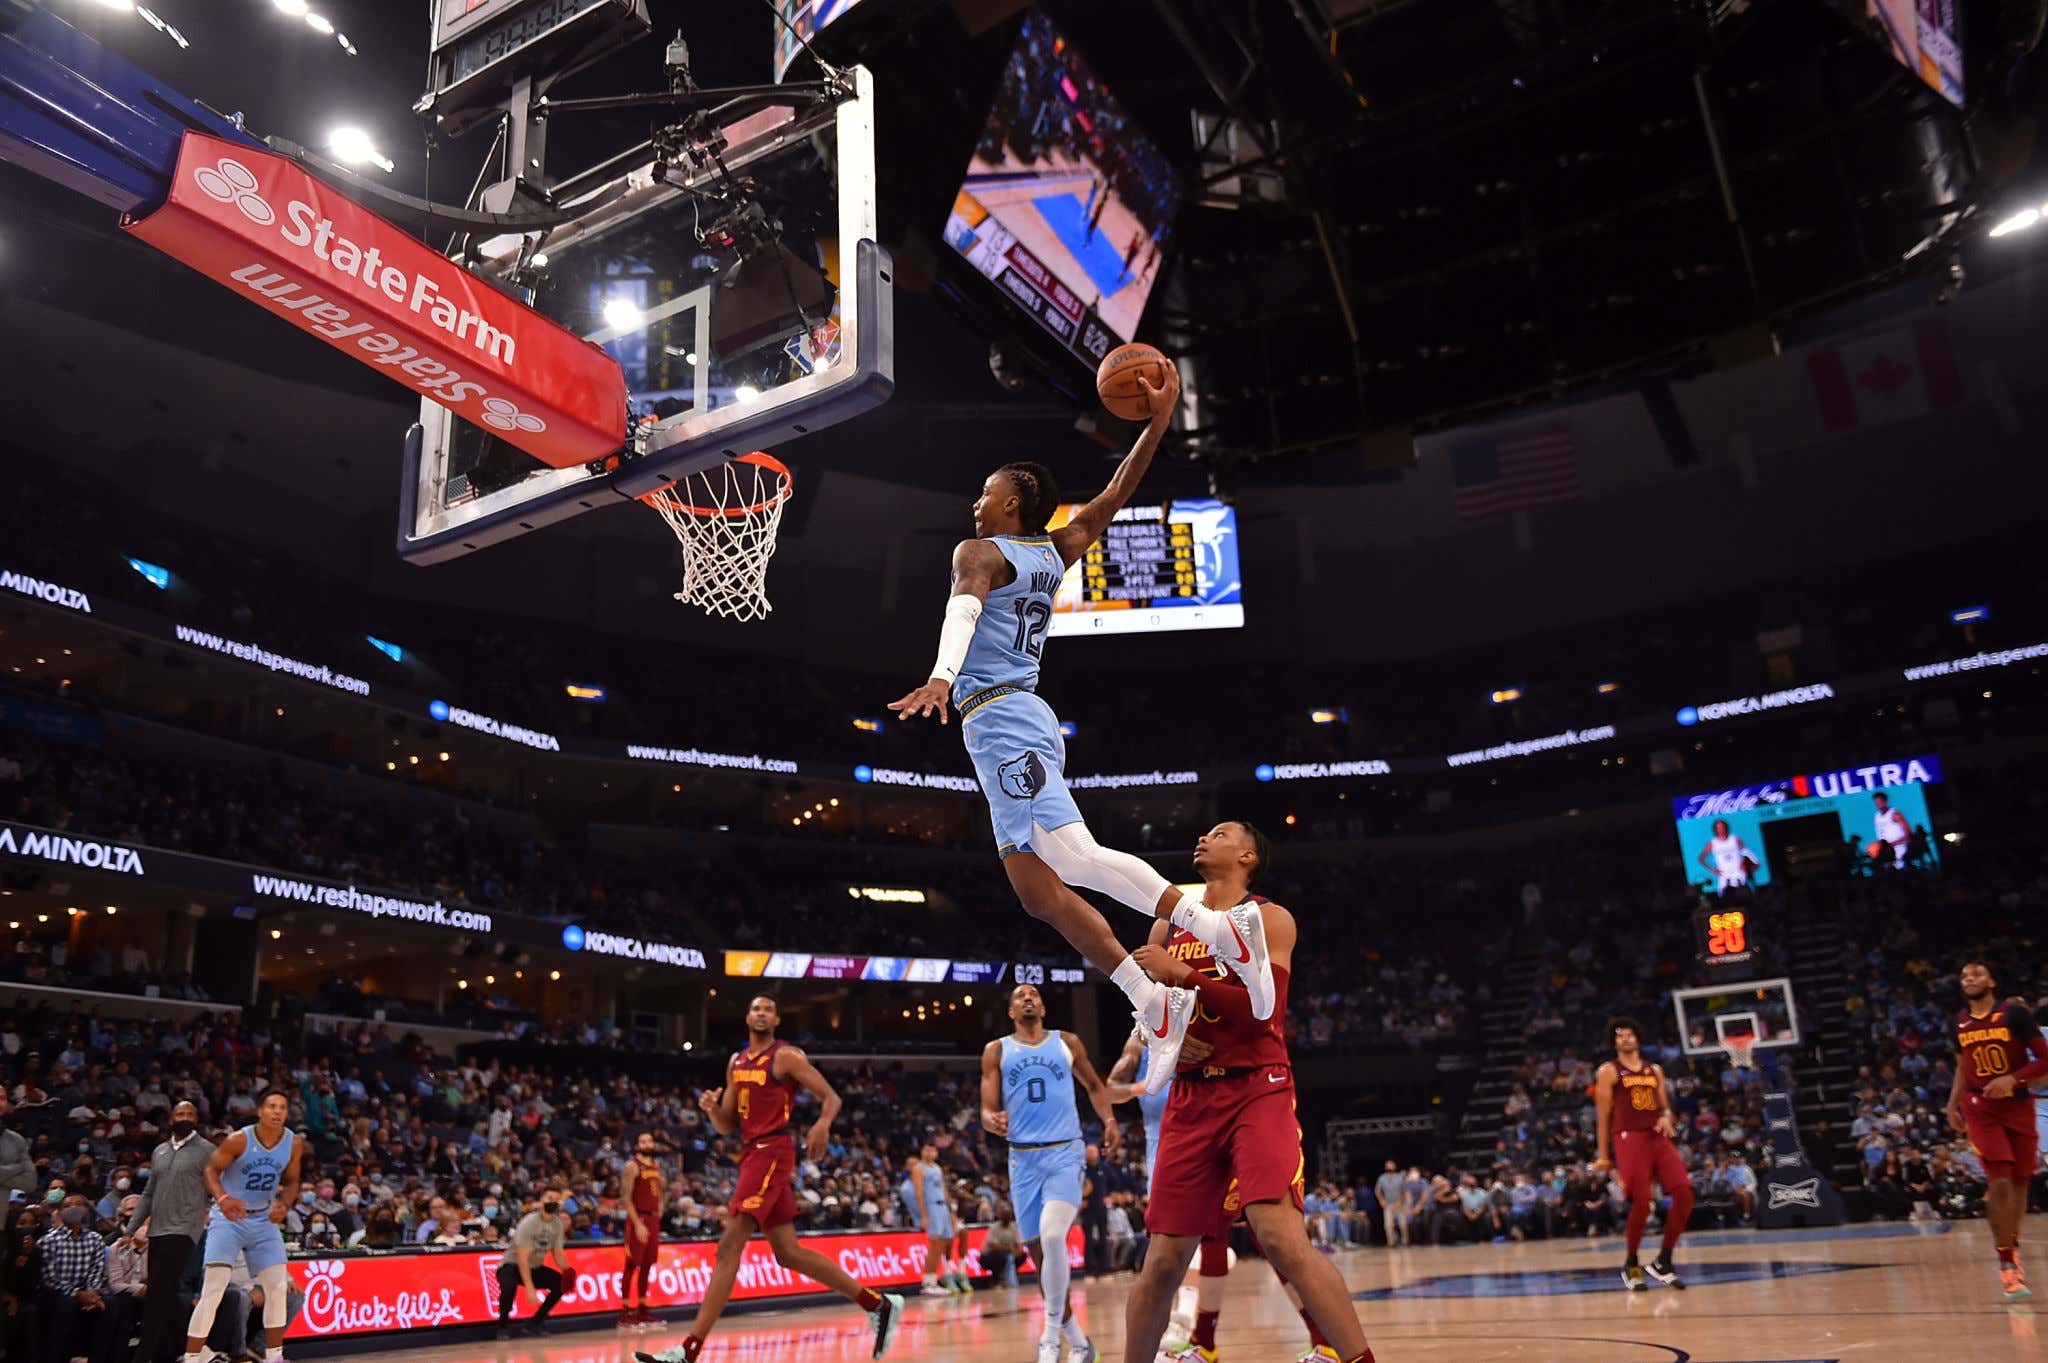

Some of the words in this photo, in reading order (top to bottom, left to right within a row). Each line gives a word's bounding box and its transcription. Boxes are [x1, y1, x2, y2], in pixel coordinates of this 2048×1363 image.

[0, 571, 91, 613] MINOLTA
[1013, 597, 1050, 659] 12
[176, 624, 370, 696] www.reshapework.com
[1698, 697, 1760, 722] KONICA
[1761, 684, 1834, 710] MINOLTA
[449, 706, 500, 737] KONICA
[501, 723, 560, 752] MINOLTA
[1447, 726, 1615, 767] www.reshapework.com
[627, 745, 798, 774] www.reshapework.com
[1274, 764, 1328, 779] KONICA
[1329, 760, 1391, 776] MINOLTA
[873, 768, 922, 787] KONICA
[924, 774, 979, 793] MINOLTA
[1813, 760, 1931, 798] ULTRA
[21, 833, 144, 875] MINOLTA
[253, 874, 492, 933] www.reshapework.com
[585, 931, 643, 960] KONICA
[645, 943, 707, 969] MINOLTA
[1008, 1055, 1064, 1087] GRIZZLIES
[1972, 1044, 2008, 1077] 10
[1027, 1077, 1046, 1103] 0
[245, 1172, 276, 1191] 22
